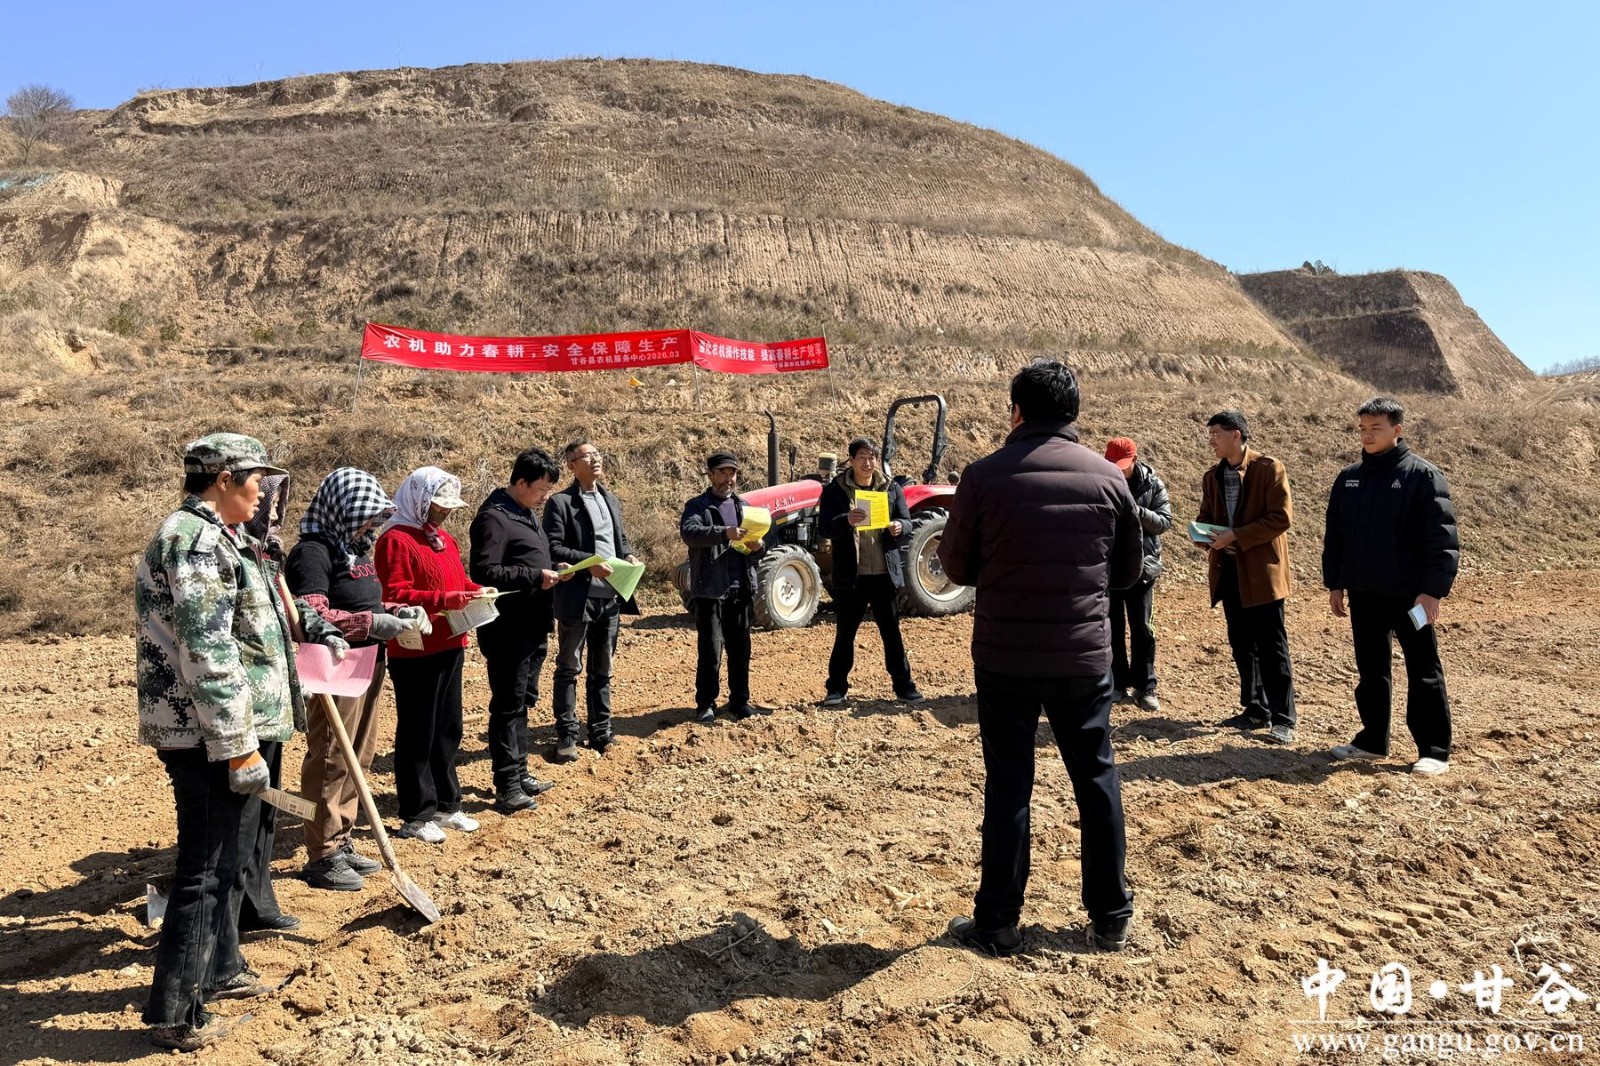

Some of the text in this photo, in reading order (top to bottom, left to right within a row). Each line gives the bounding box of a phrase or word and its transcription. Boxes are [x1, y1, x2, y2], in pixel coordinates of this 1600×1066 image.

[384, 334, 679, 358] 农机助力春耕，安全保障生产
